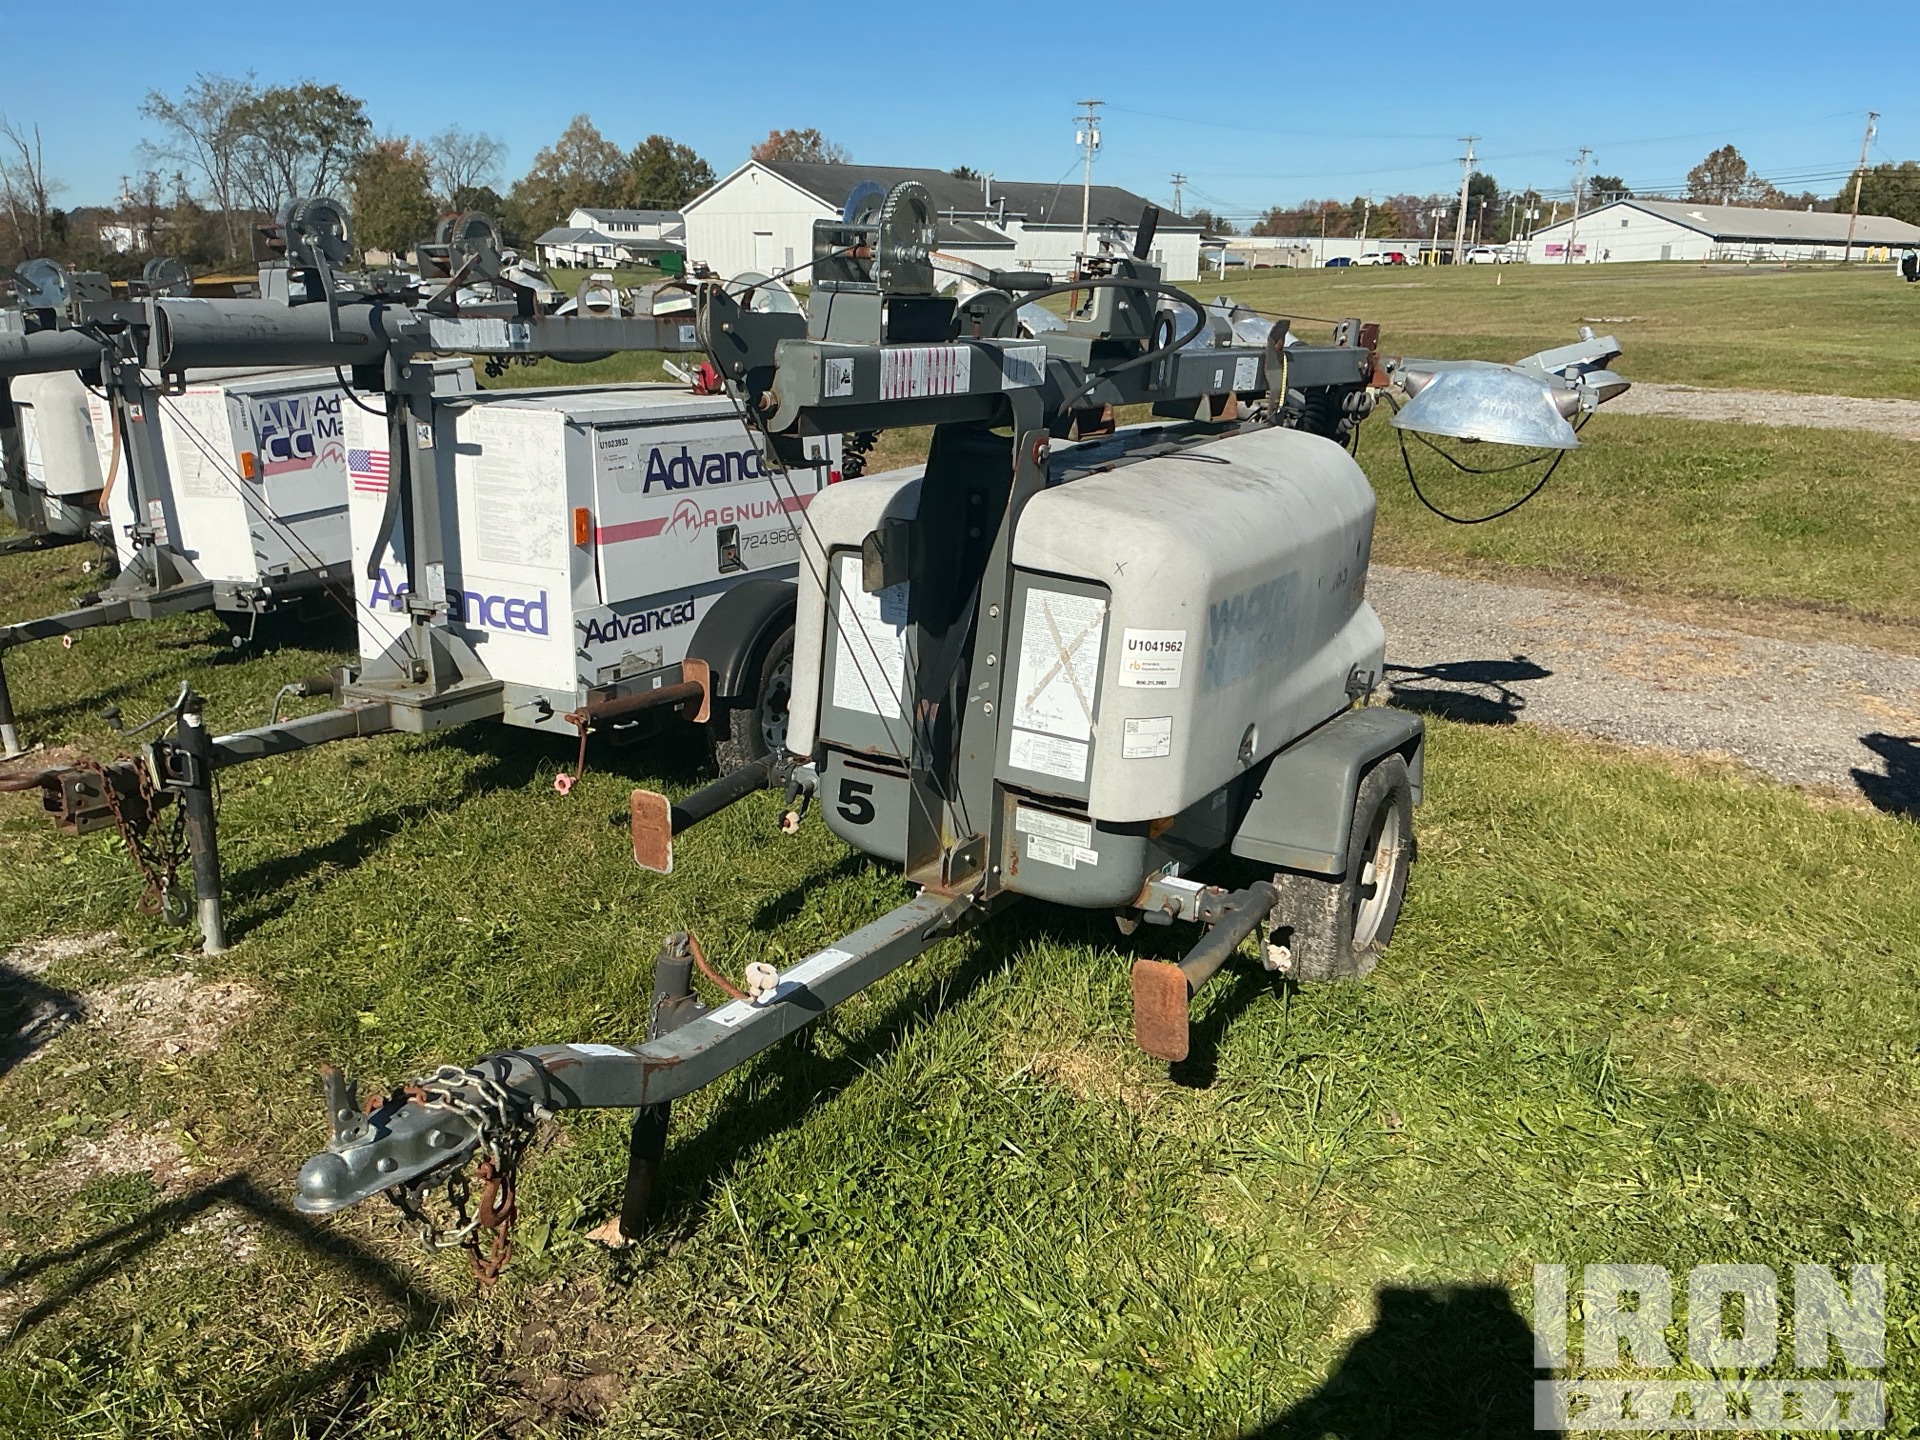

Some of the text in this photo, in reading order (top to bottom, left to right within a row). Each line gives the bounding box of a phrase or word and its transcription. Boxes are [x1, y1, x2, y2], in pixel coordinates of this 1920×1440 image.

[600, 437, 629, 450] U1023932
[583, 595, 695, 648] Advanced
[1128, 639, 1183, 652] U1041962
[836, 777, 876, 826] 5
